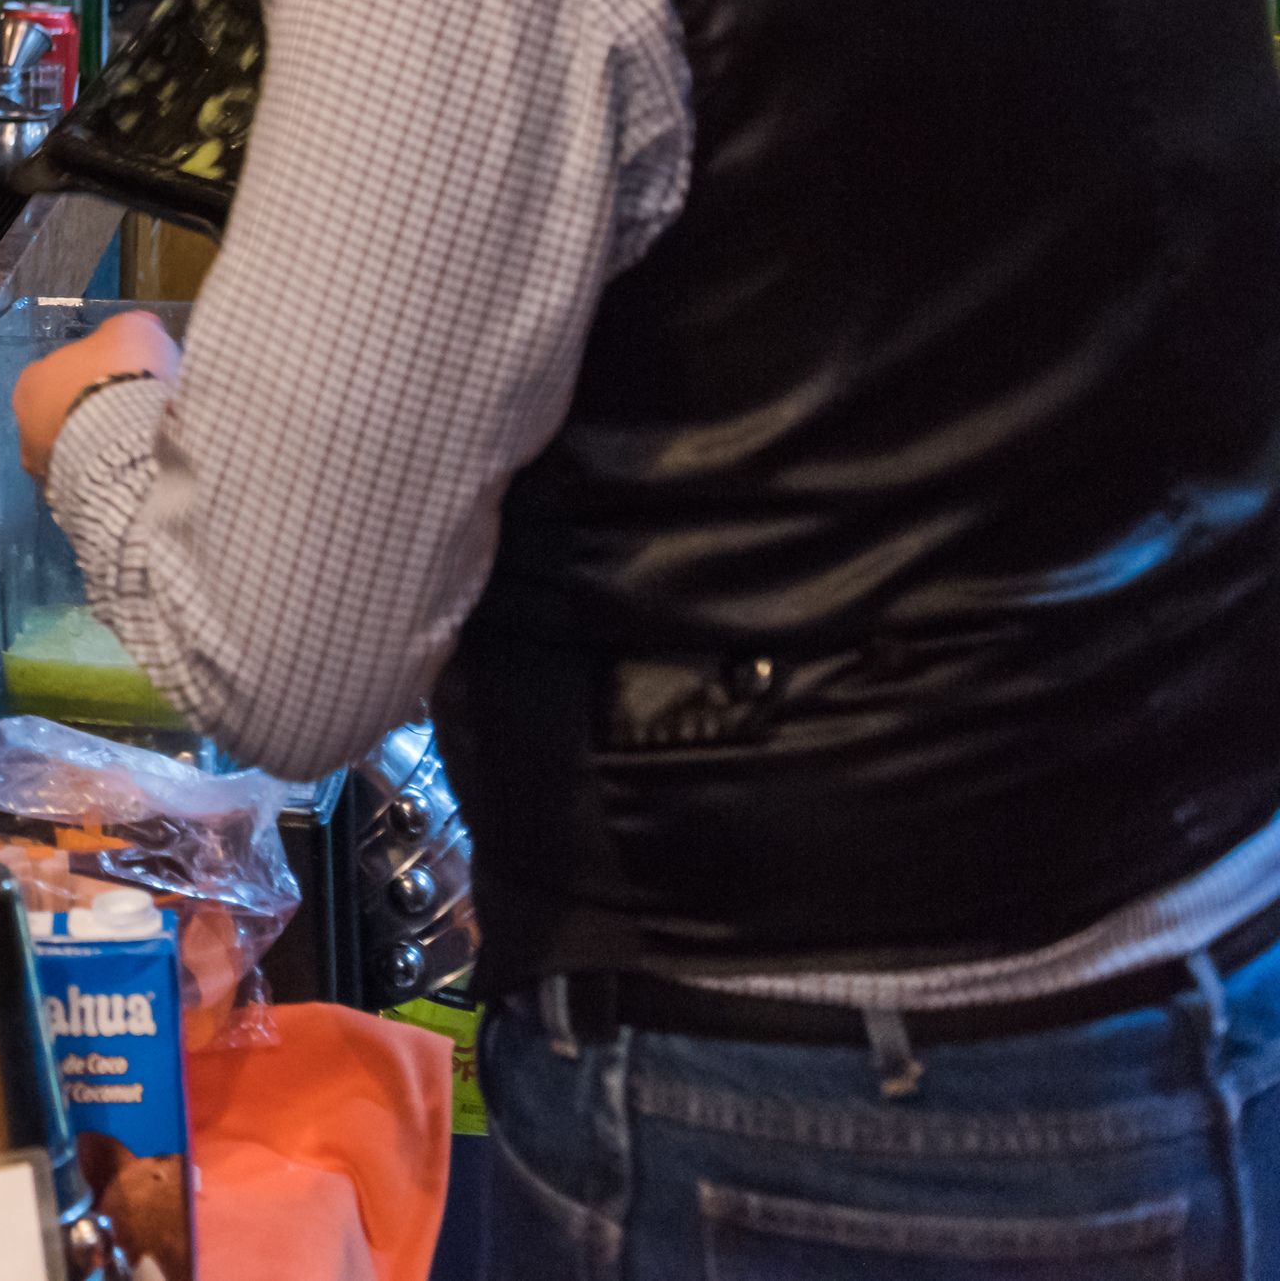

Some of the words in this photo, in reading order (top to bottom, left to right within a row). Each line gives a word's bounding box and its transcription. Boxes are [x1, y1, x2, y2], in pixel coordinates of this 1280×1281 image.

[43, 984, 157, 1038] ahua
[87, 1052, 128, 1075] Coco
[72, 1082, 144, 1103] Coconut
